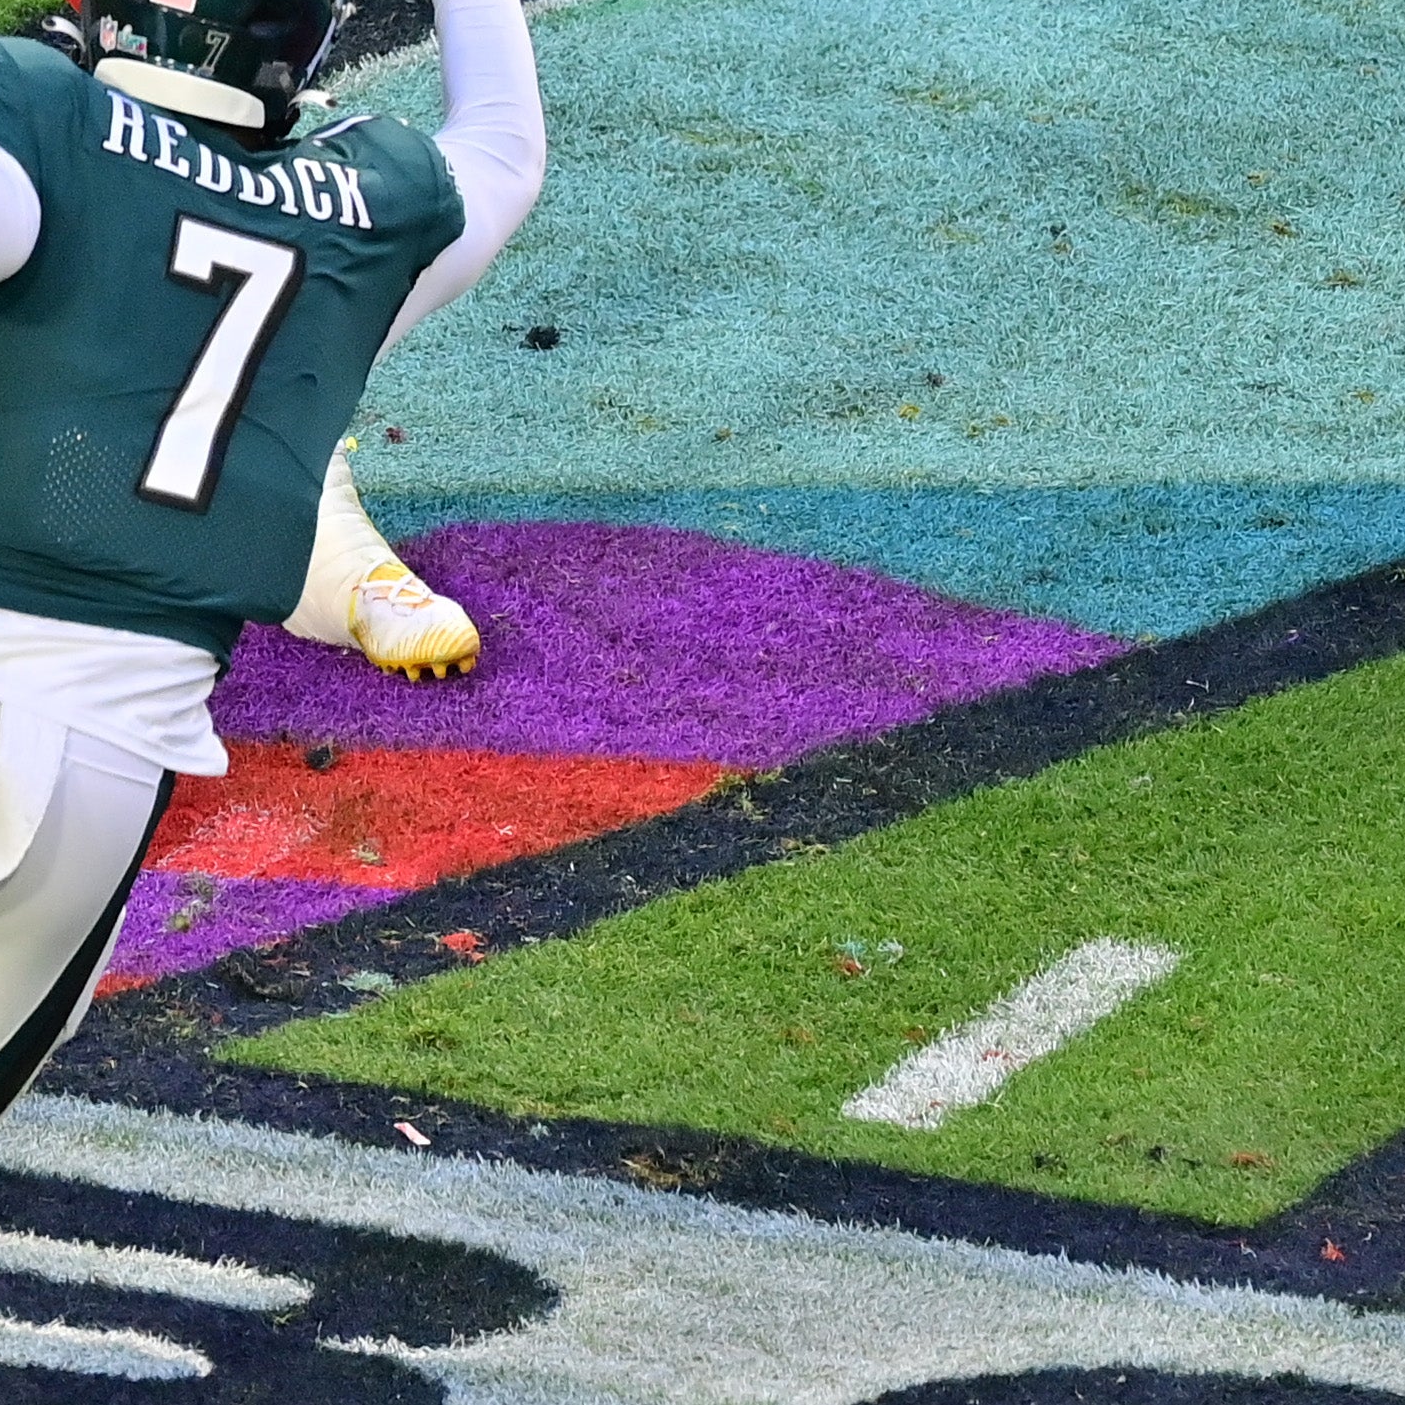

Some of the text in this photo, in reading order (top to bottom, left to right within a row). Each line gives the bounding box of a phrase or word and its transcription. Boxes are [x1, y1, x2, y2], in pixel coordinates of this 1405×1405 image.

[198, 29, 230, 77] 7
[103, 89, 373, 230] REDDICK
[138, 210, 304, 514] 7
